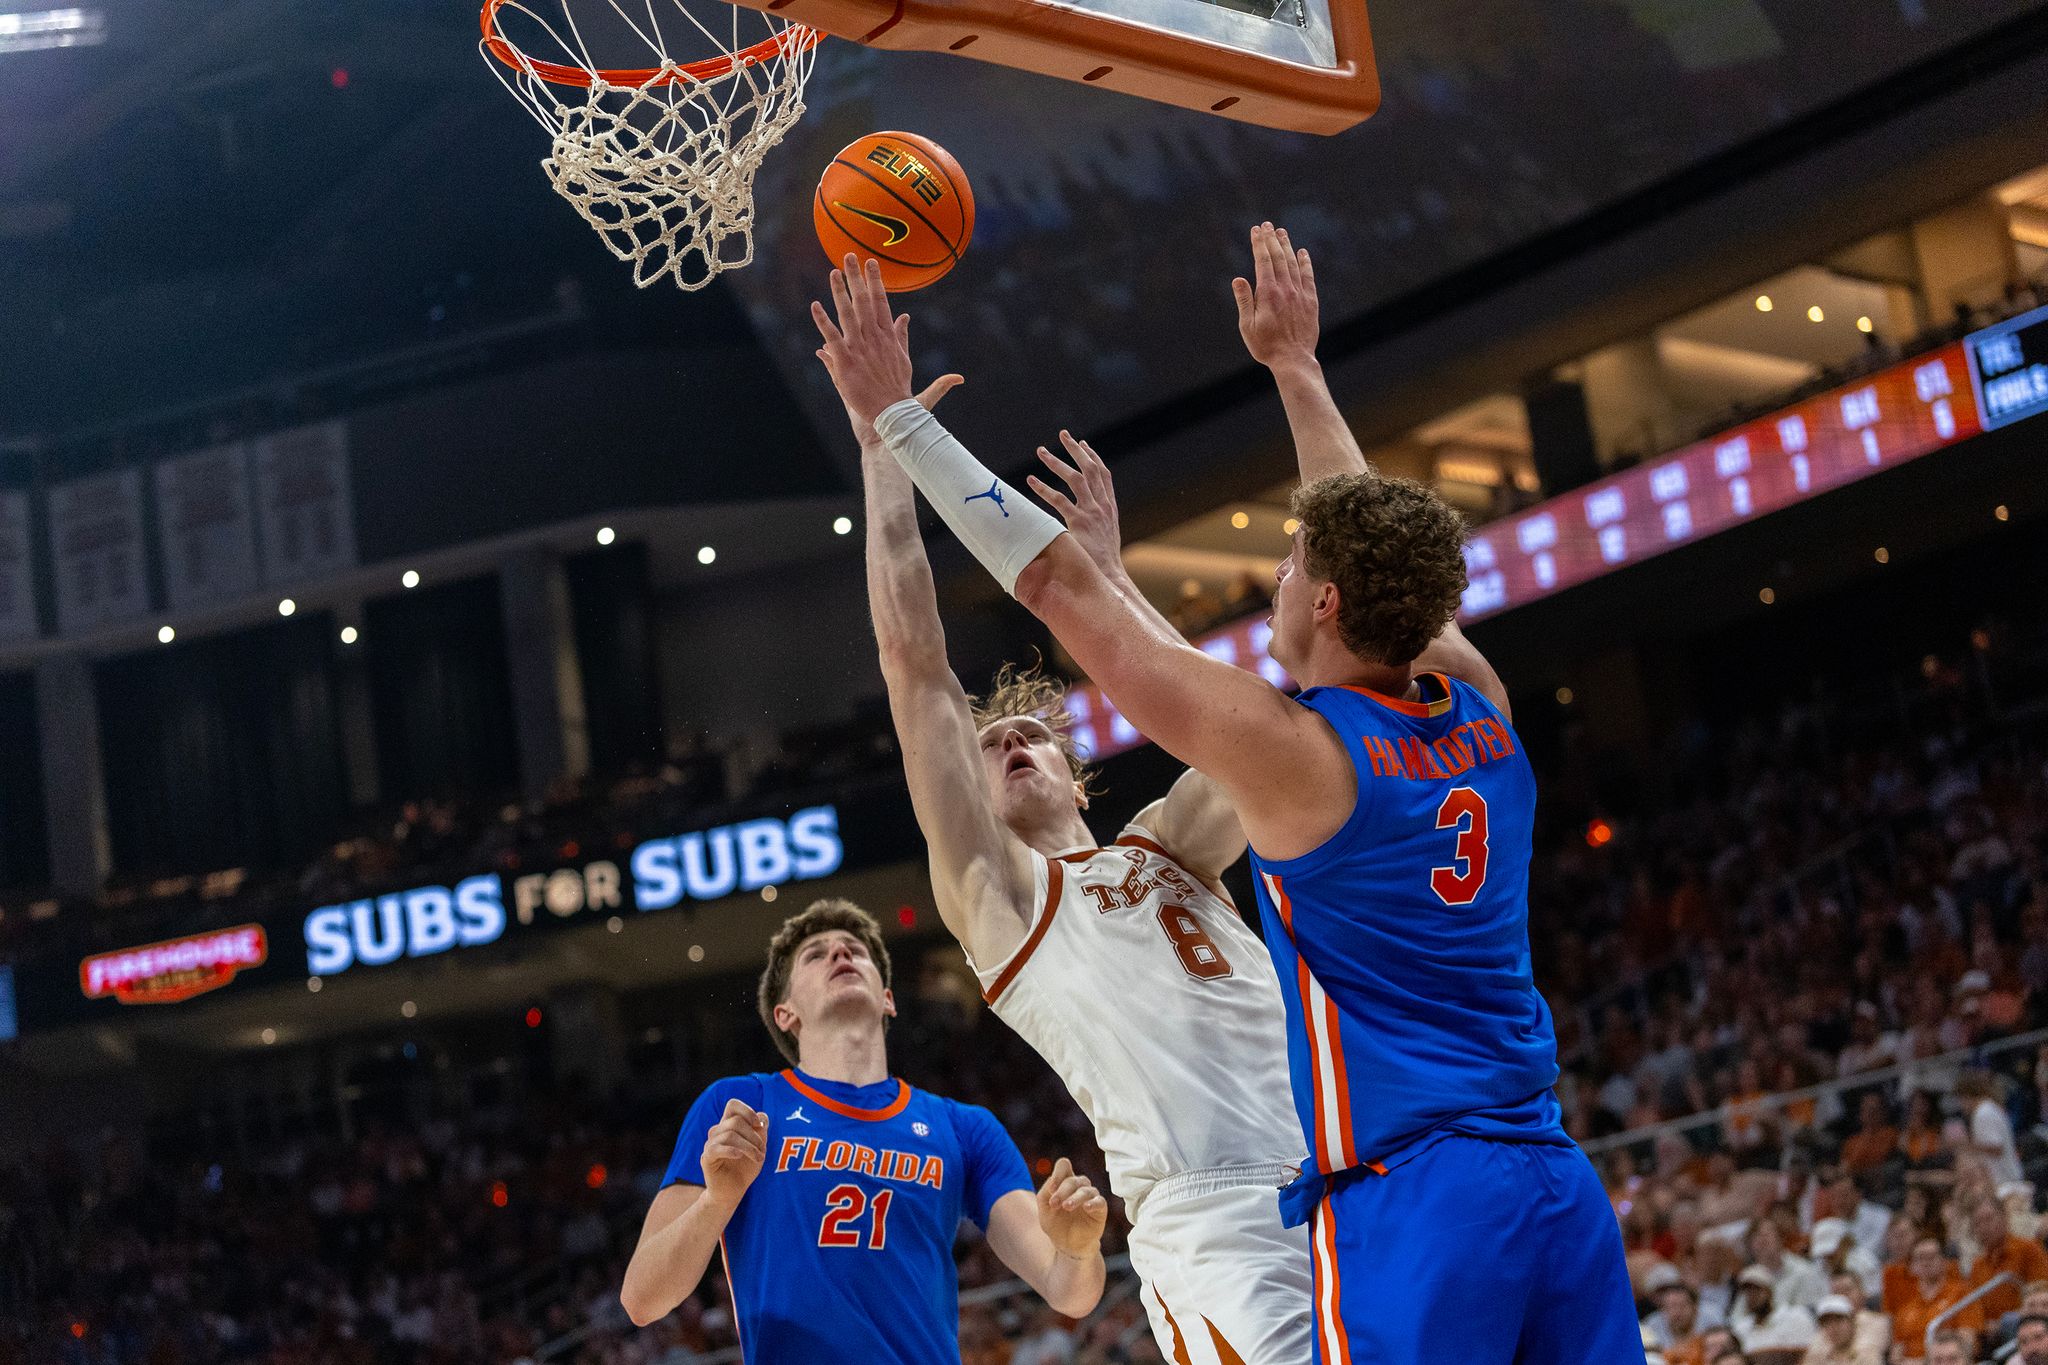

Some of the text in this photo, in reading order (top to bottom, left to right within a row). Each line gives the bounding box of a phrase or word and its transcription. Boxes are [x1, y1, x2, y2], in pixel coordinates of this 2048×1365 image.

[866, 145, 944, 207] ELITE
[1430, 786, 1489, 906] 3
[303, 805, 843, 975] SUBS FOR SUBS
[1156, 901, 1234, 982] 8
[775, 1136, 944, 1191] FLORIDA
[818, 1183, 894, 1250] 21
